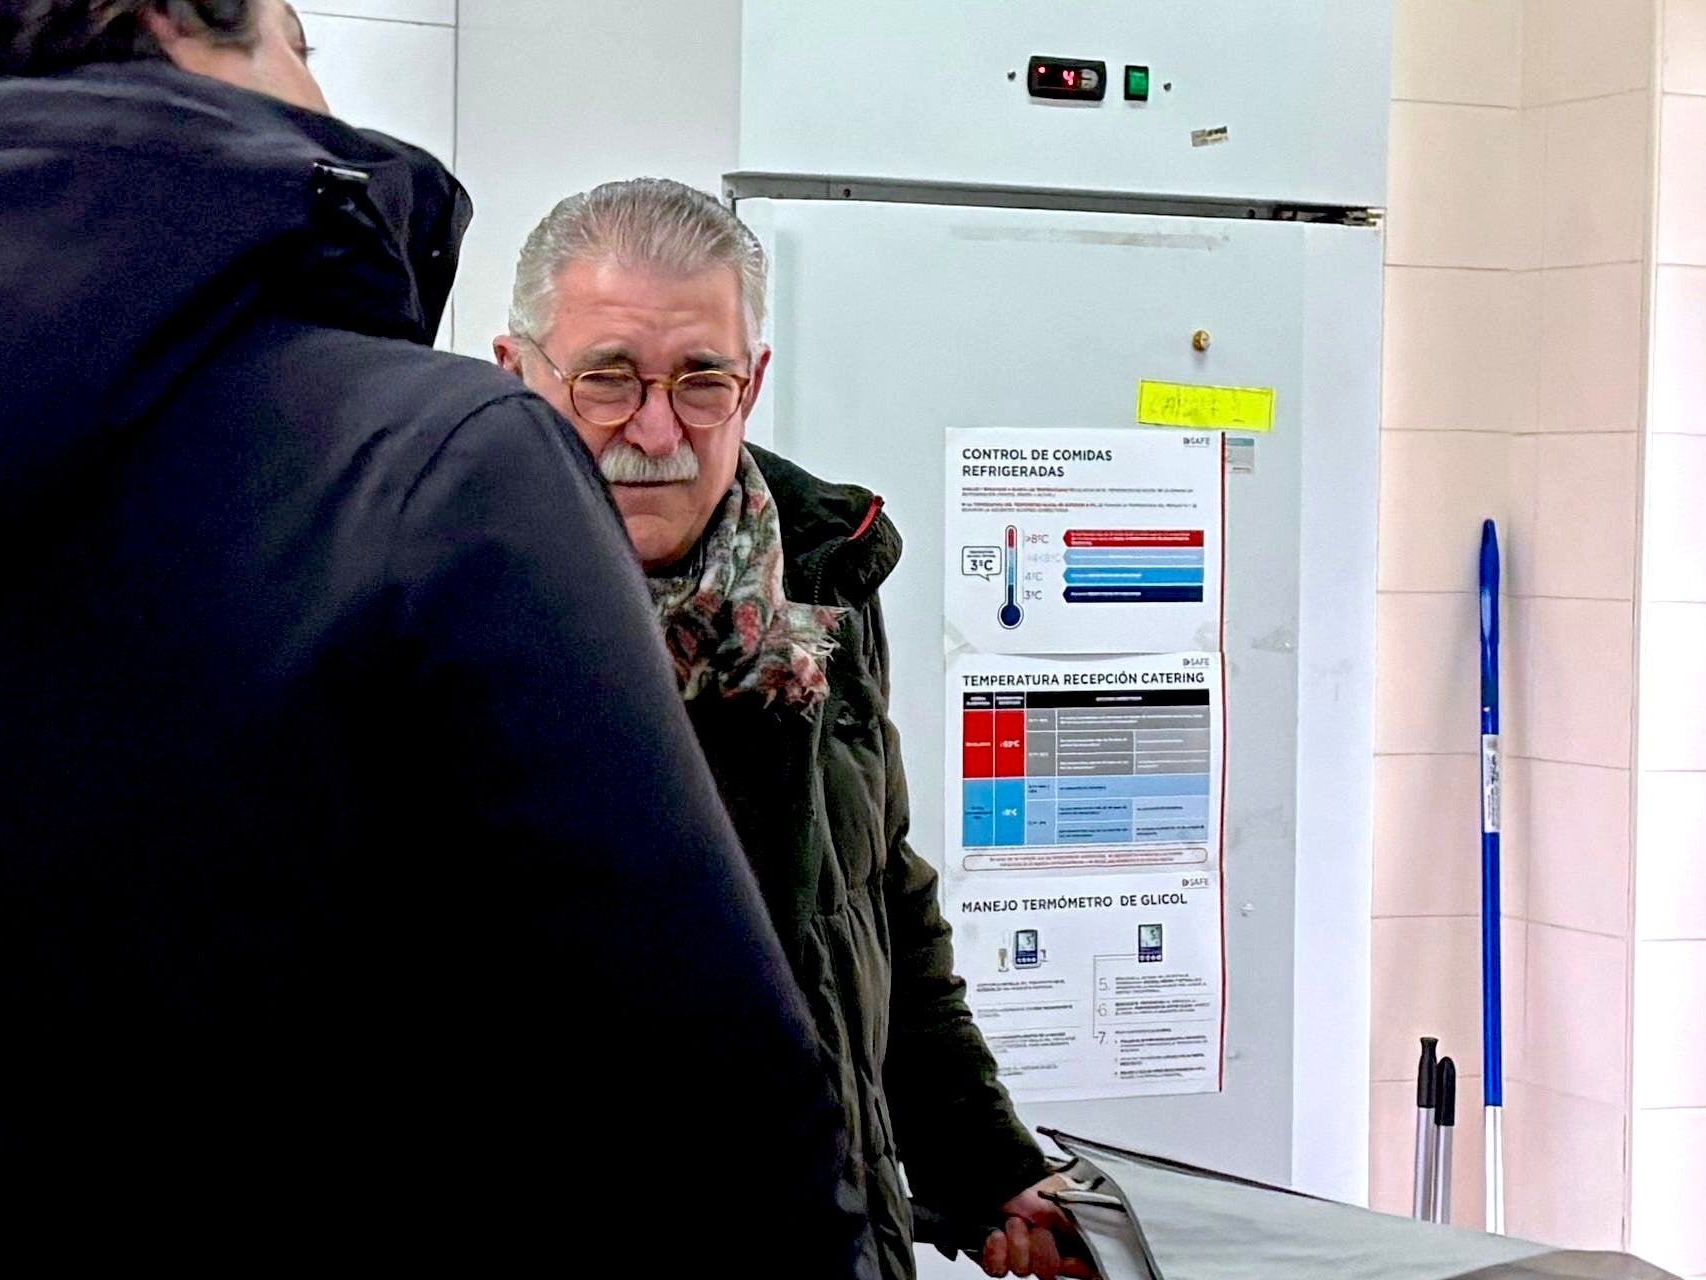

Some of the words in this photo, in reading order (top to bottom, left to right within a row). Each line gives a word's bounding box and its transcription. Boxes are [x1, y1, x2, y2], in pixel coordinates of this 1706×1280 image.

[962, 448, 1028, 462] CONTROL
[1031, 448, 1048, 462] DE
[1052, 448, 1113, 462] COMIDAS
[962, 464, 1065, 478] REFRIGERADAS
[962, 673, 1060, 687] TEMPERATURA
[1063, 670, 1138, 686] RECEPCIÓN
[1141, 671, 1205, 685] CATERING
[961, 900, 1018, 913] MANEJO
[1022, 895, 1113, 911] TERMÓMETRO
[1120, 894, 1137, 907] DE
